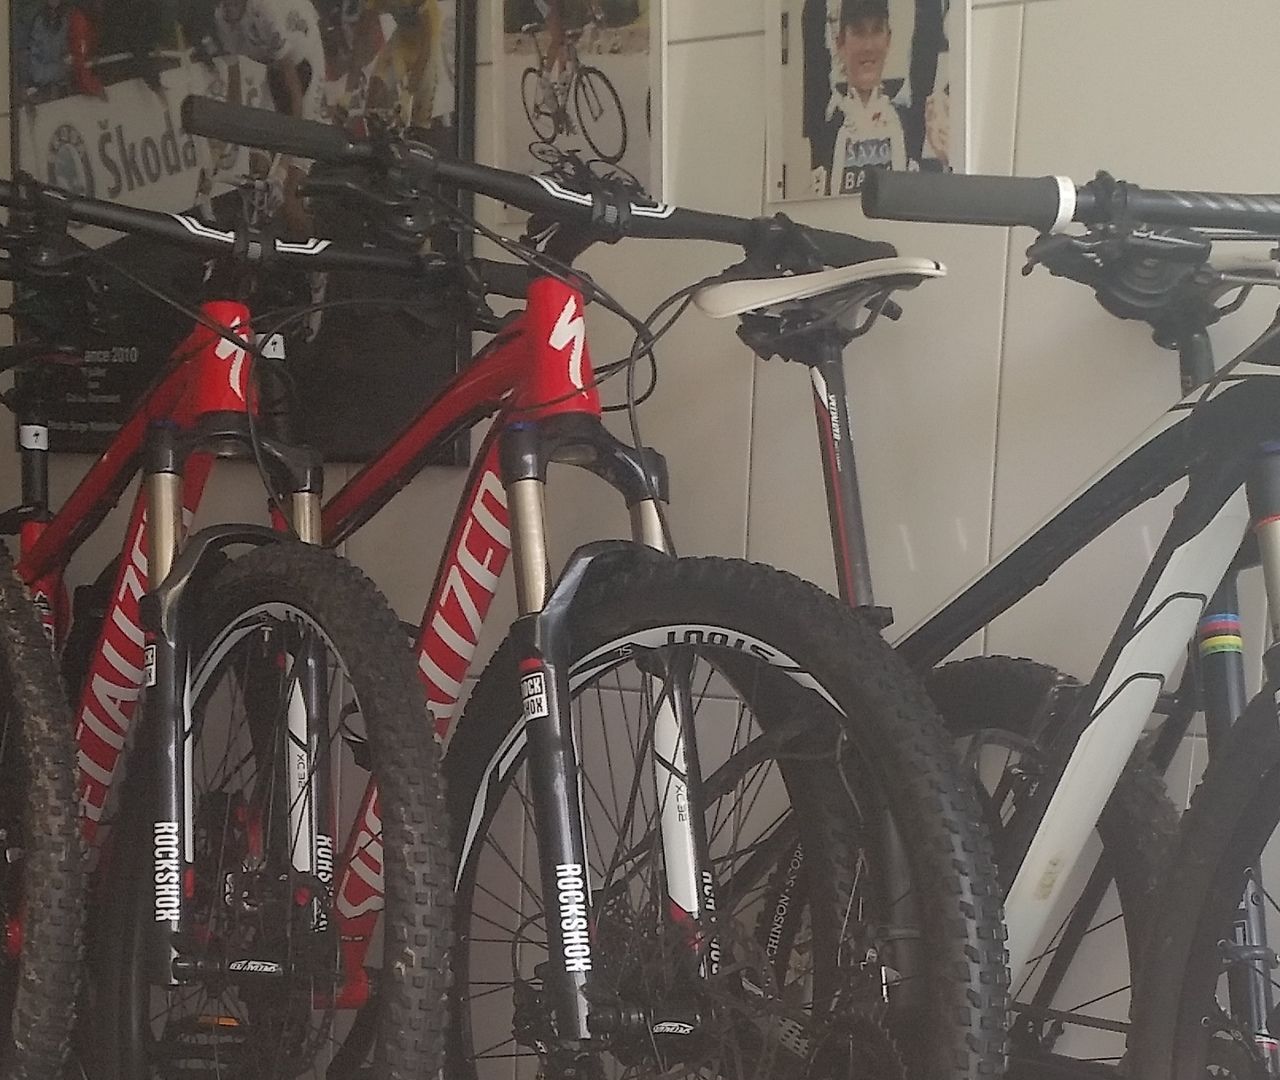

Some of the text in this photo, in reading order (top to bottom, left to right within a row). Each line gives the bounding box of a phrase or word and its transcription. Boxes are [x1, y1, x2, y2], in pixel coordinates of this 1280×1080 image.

[97, 111, 197, 199] Škoda
[846, 140, 890, 162] SAXO
[844, 170, 866, 190] BA
[521, 677, 543, 699] OCK
[154, 822, 180, 921] ROCKSHOX
[556, 863, 592, 972] ROCKSHOX
